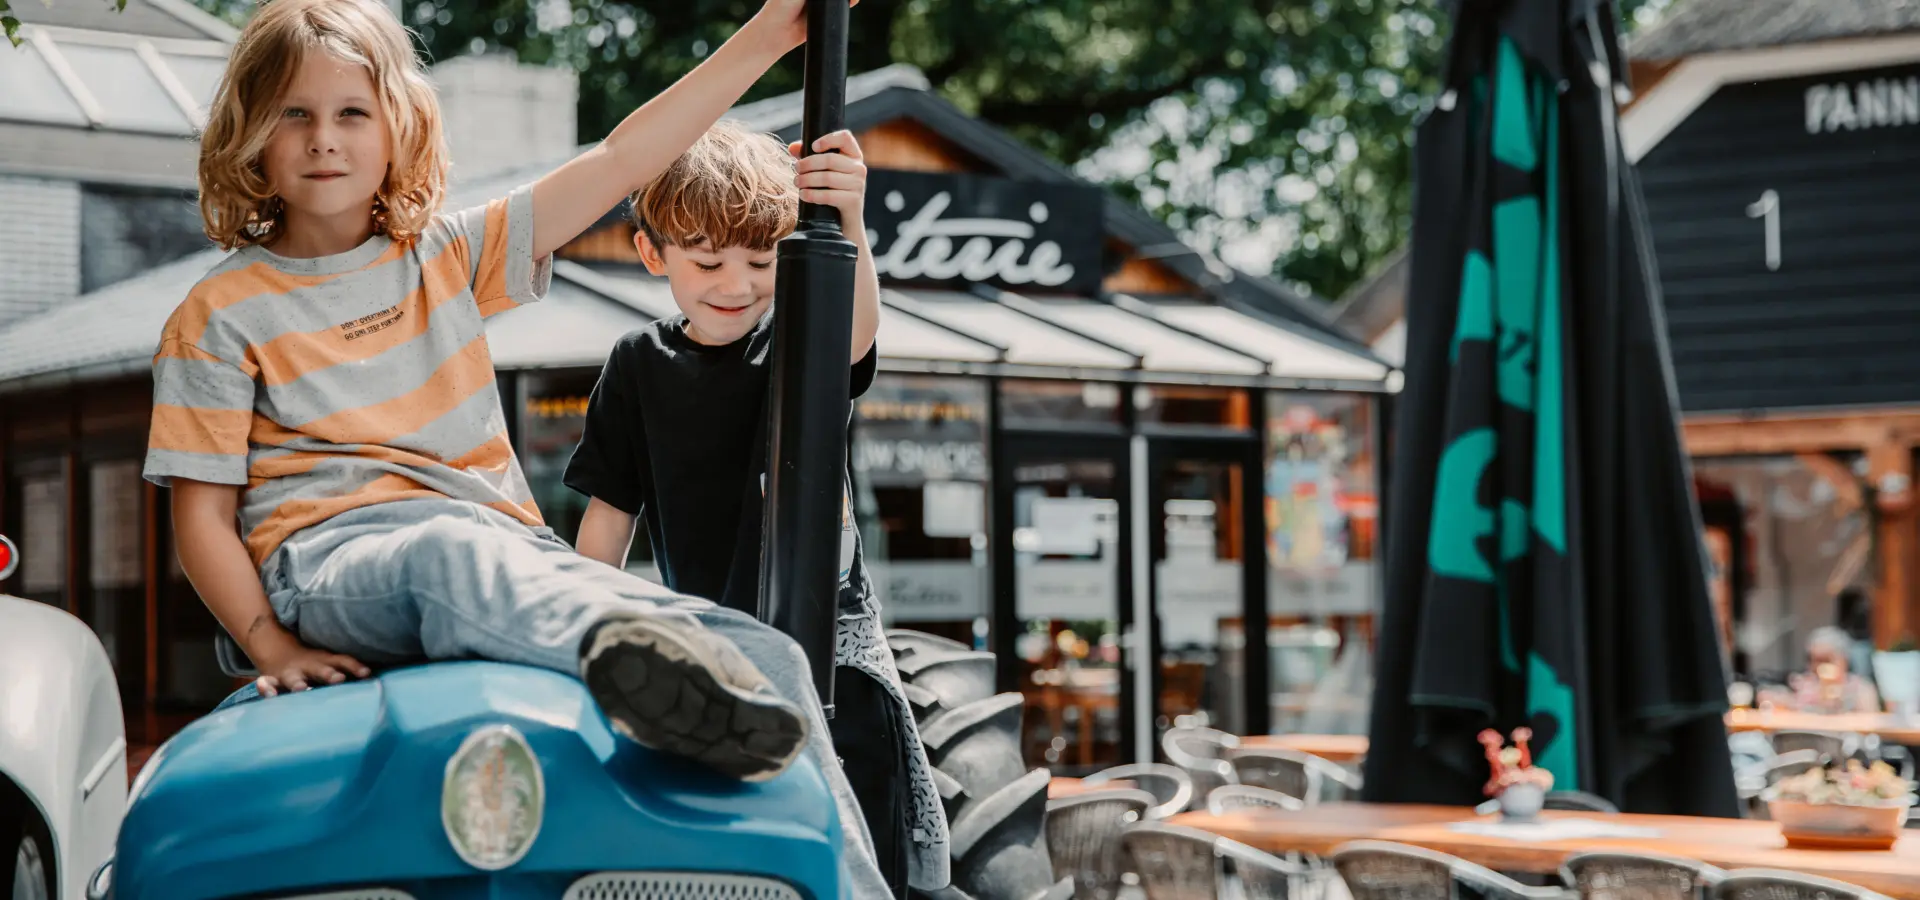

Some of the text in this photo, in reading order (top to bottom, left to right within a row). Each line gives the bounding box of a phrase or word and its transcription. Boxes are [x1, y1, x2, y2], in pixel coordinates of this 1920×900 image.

[1745, 188, 1781, 272] 1
[359, 308, 390, 324] OVERTHINK
[344, 332, 354, 340] GO
[367, 323, 380, 333] STEP
